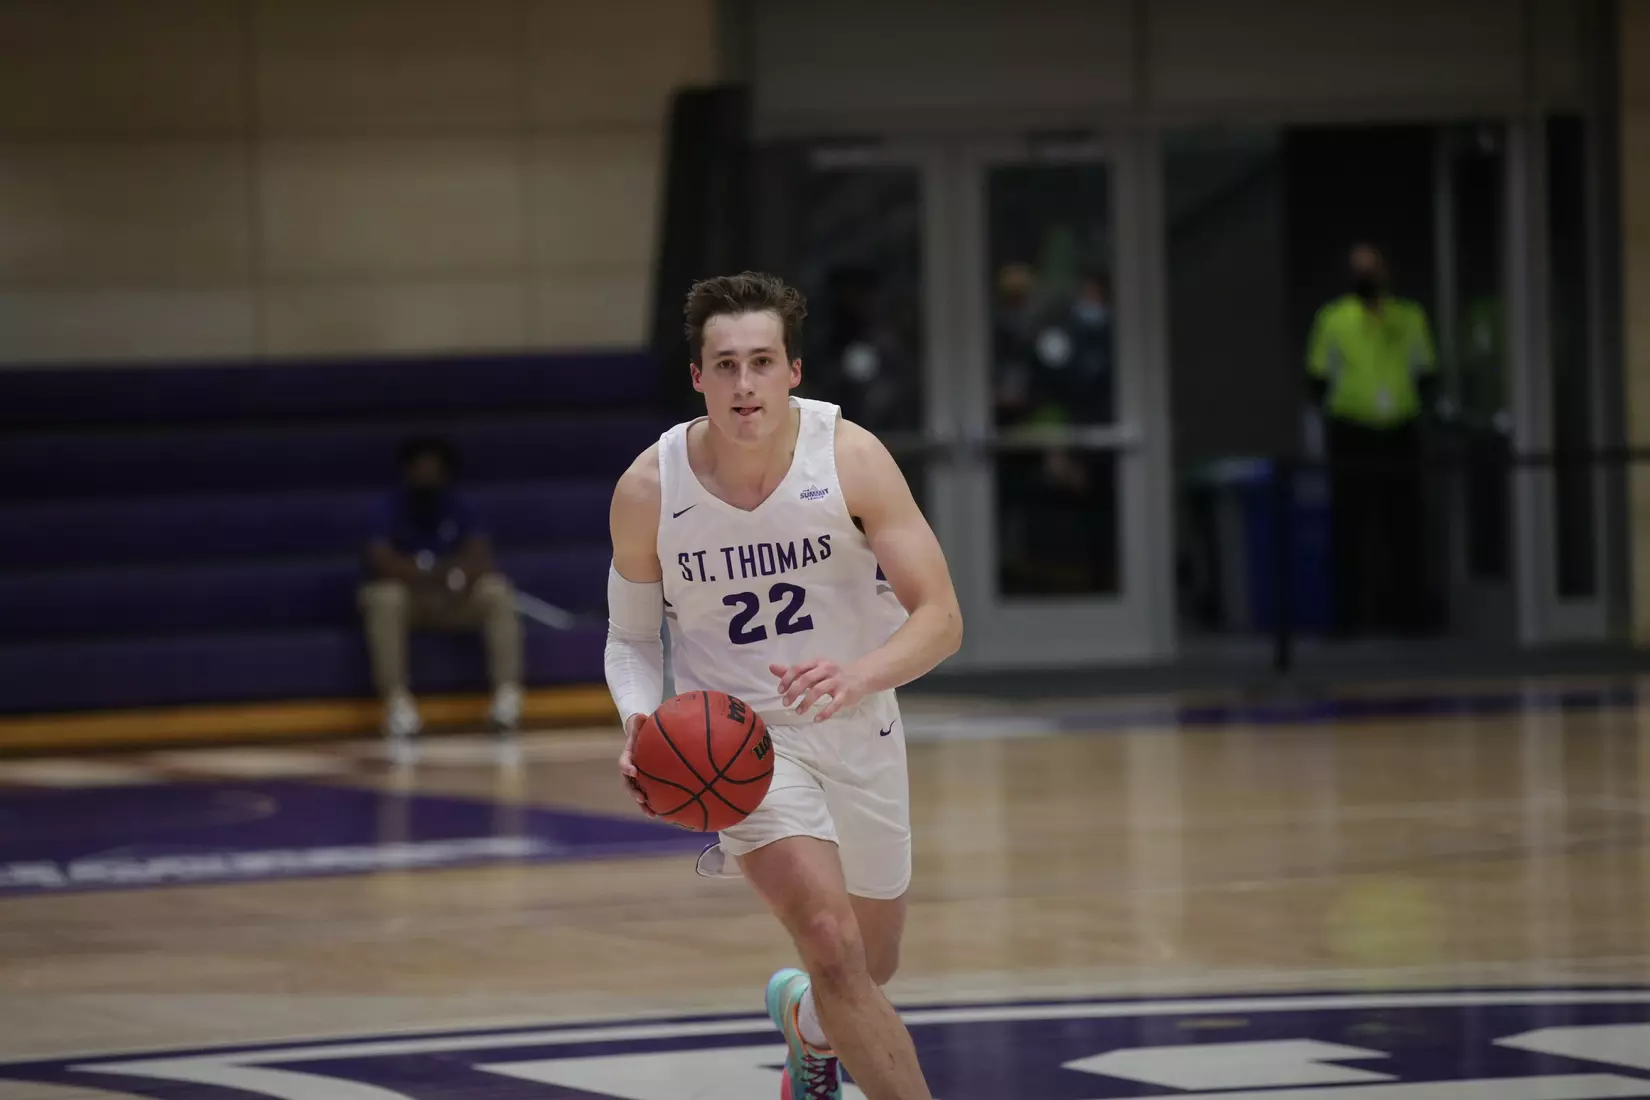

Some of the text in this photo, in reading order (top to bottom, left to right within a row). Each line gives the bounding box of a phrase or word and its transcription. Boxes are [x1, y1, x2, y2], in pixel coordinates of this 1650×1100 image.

[678, 534, 832, 582] ST. THOMAS
[722, 582, 814, 645] 22
